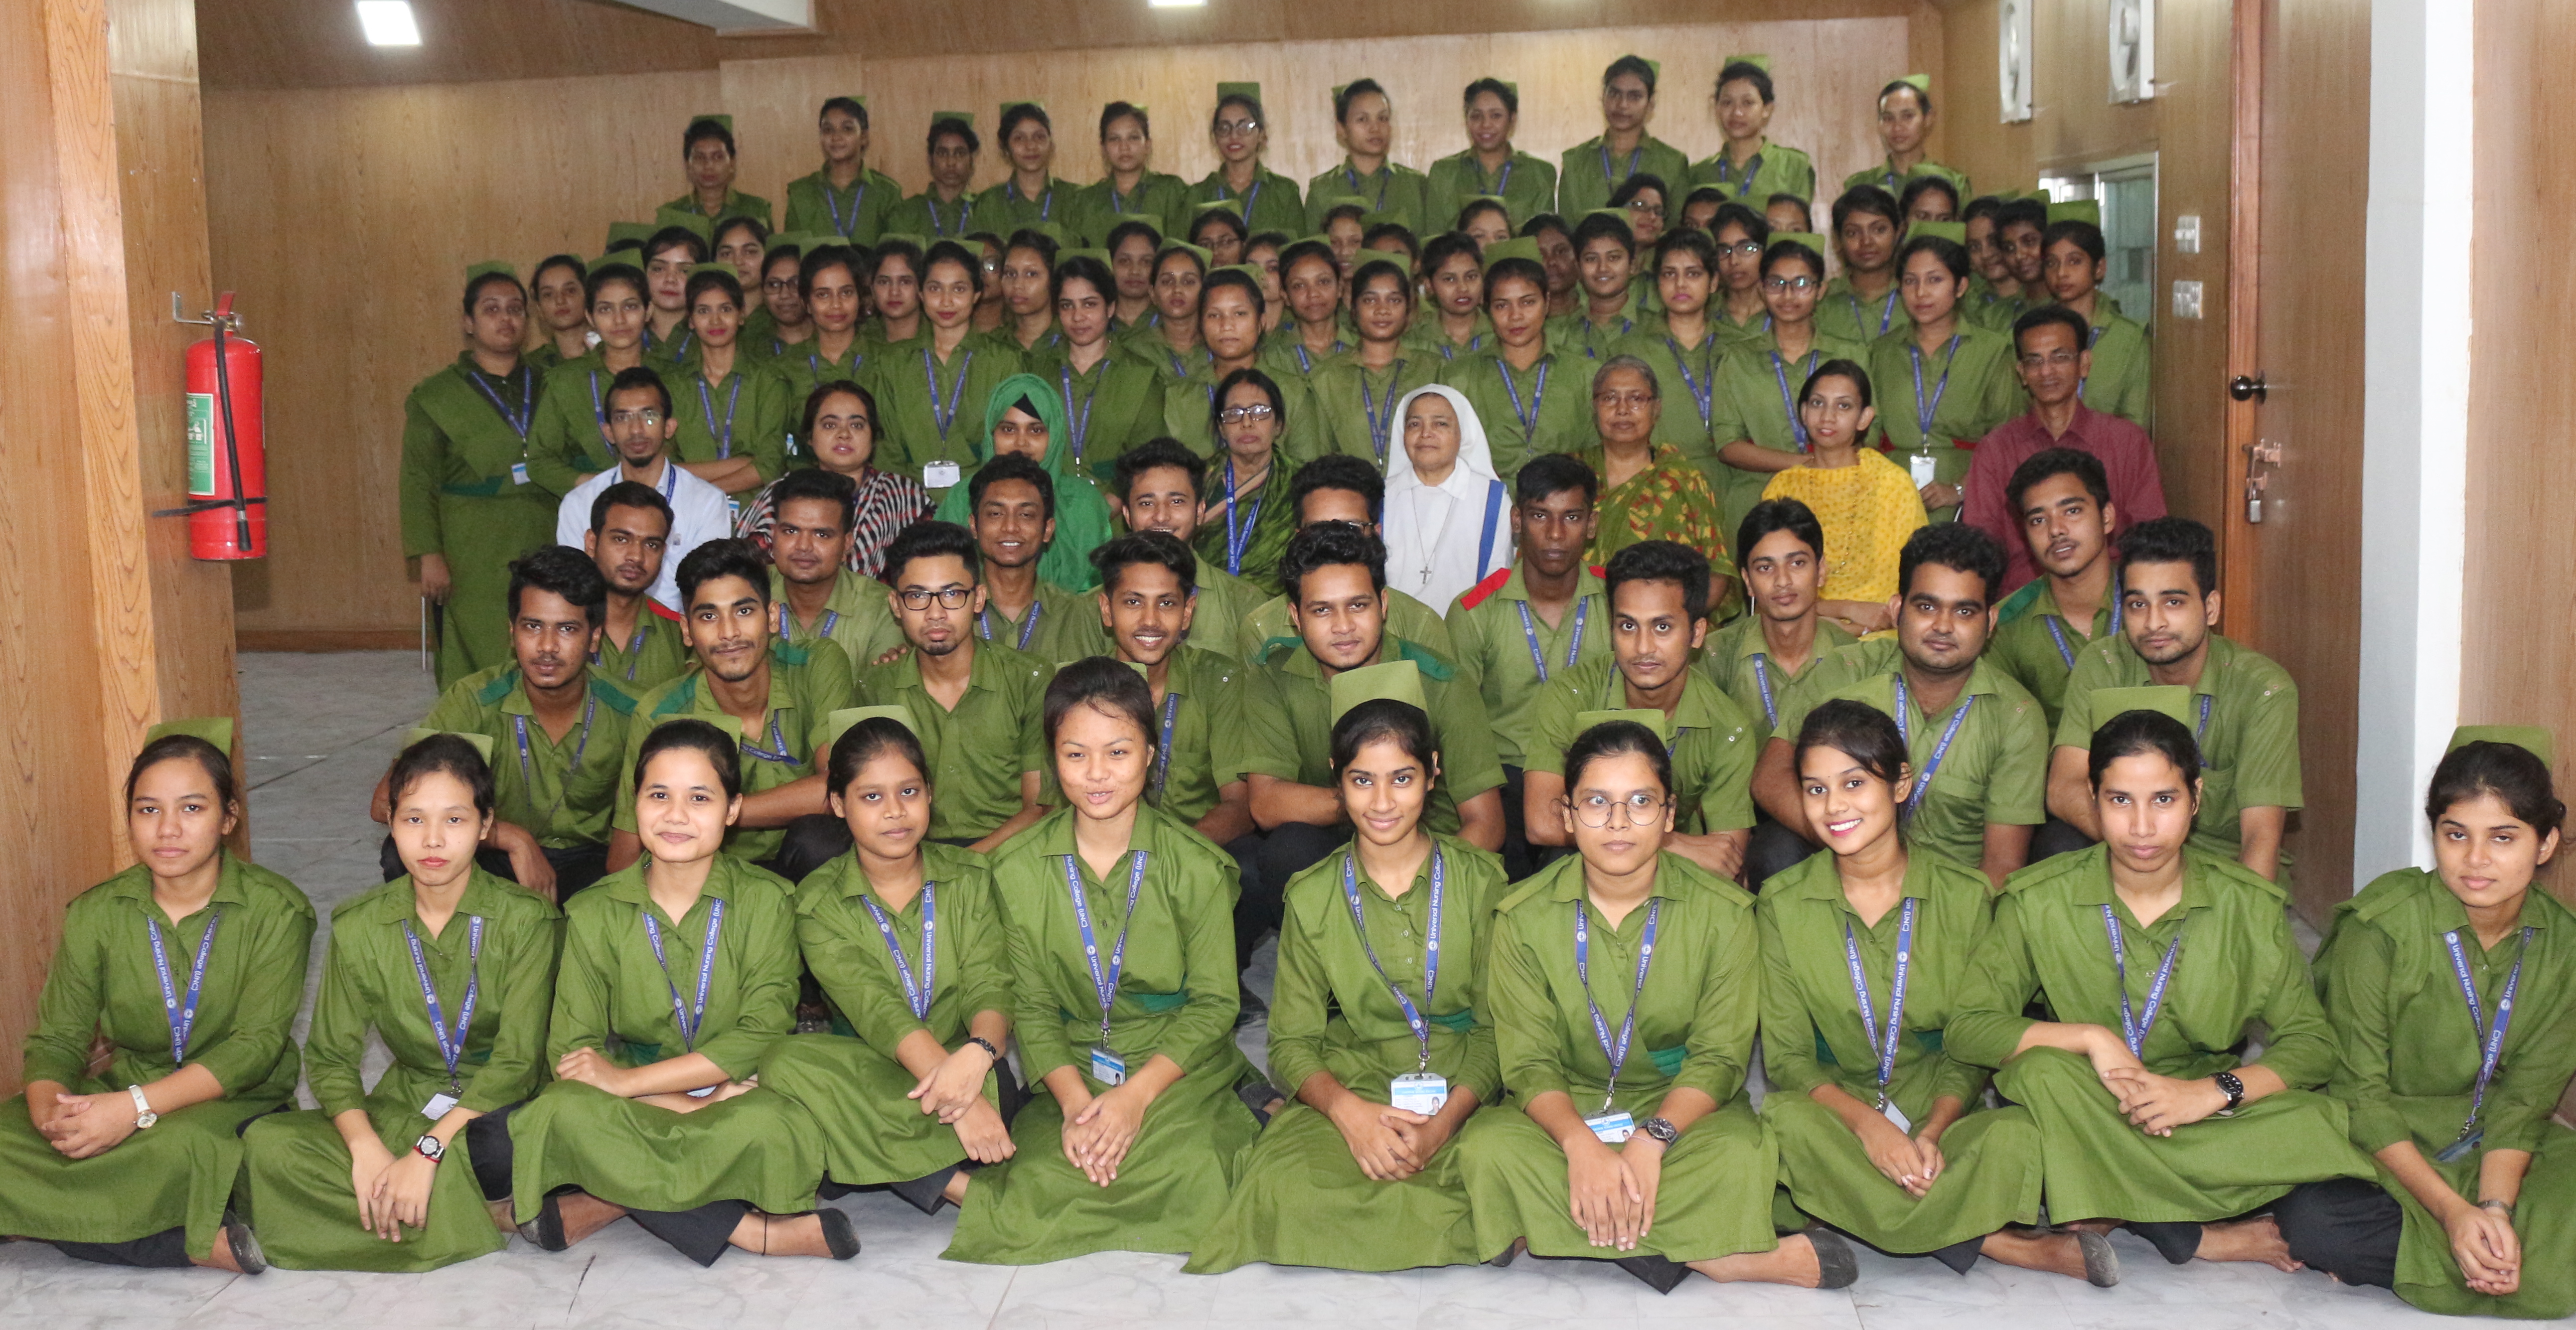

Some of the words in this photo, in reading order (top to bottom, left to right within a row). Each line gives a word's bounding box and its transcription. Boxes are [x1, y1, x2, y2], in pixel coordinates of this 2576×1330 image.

[1943, 719, 1960, 742] College
[1934, 741, 1947, 760] (UNC)
[1129, 871, 1141, 898] College
[1135, 850, 1145, 870] (UNC)
[1066, 855, 1076, 880] Nursing
[1071, 880, 1083, 907] College
[1077, 908, 1088, 928] (UNC)
[1432, 882, 1440, 906] Nursing
[1648, 904, 1657, 925] (UNC)
[1902, 911, 1911, 932] (UNC)
[707, 917, 718, 946] College
[2107, 918, 2120, 951] Universal
[153, 940, 163, 966] Nursing
[195, 941, 209, 970] College
[410, 938, 421, 963] Nursing
[702, 946, 713, 971] Nursing
[893, 948, 906, 968] (UNC)
[1846, 937, 1857, 959] (UNC)
[158, 966, 171, 998] Universal
[191, 970, 202, 991] (UNC)
[417, 963, 431, 993] Universal
[901, 969, 915, 996] College
[1090, 956, 1103, 985] Universal
[1851, 960, 1863, 990] College
[1896, 964, 1905, 997] Universal
[2451, 944, 2467, 978] Universal
[2463, 978, 2475, 1005] Nursing
[464, 984, 475, 1010] College
[697, 972, 708, 1003] Universal
[2150, 973, 2166, 1000] Nursing
[1859, 991, 1870, 1017] Nursing
[1890, 998, 1900, 1024] Nursing
[2140, 1000, 2156, 1029] College
[434, 1021, 446, 1040] (UNC)
[459, 1011, 469, 1030] (UNC)
[1593, 1013, 1607, 1038] Nursing
[1620, 1016, 1632, 1044] College
[2123, 1007, 2134, 1036] College
[1886, 1026, 1897, 1054] College
[2488, 1030, 2501, 1052] (UNC)
